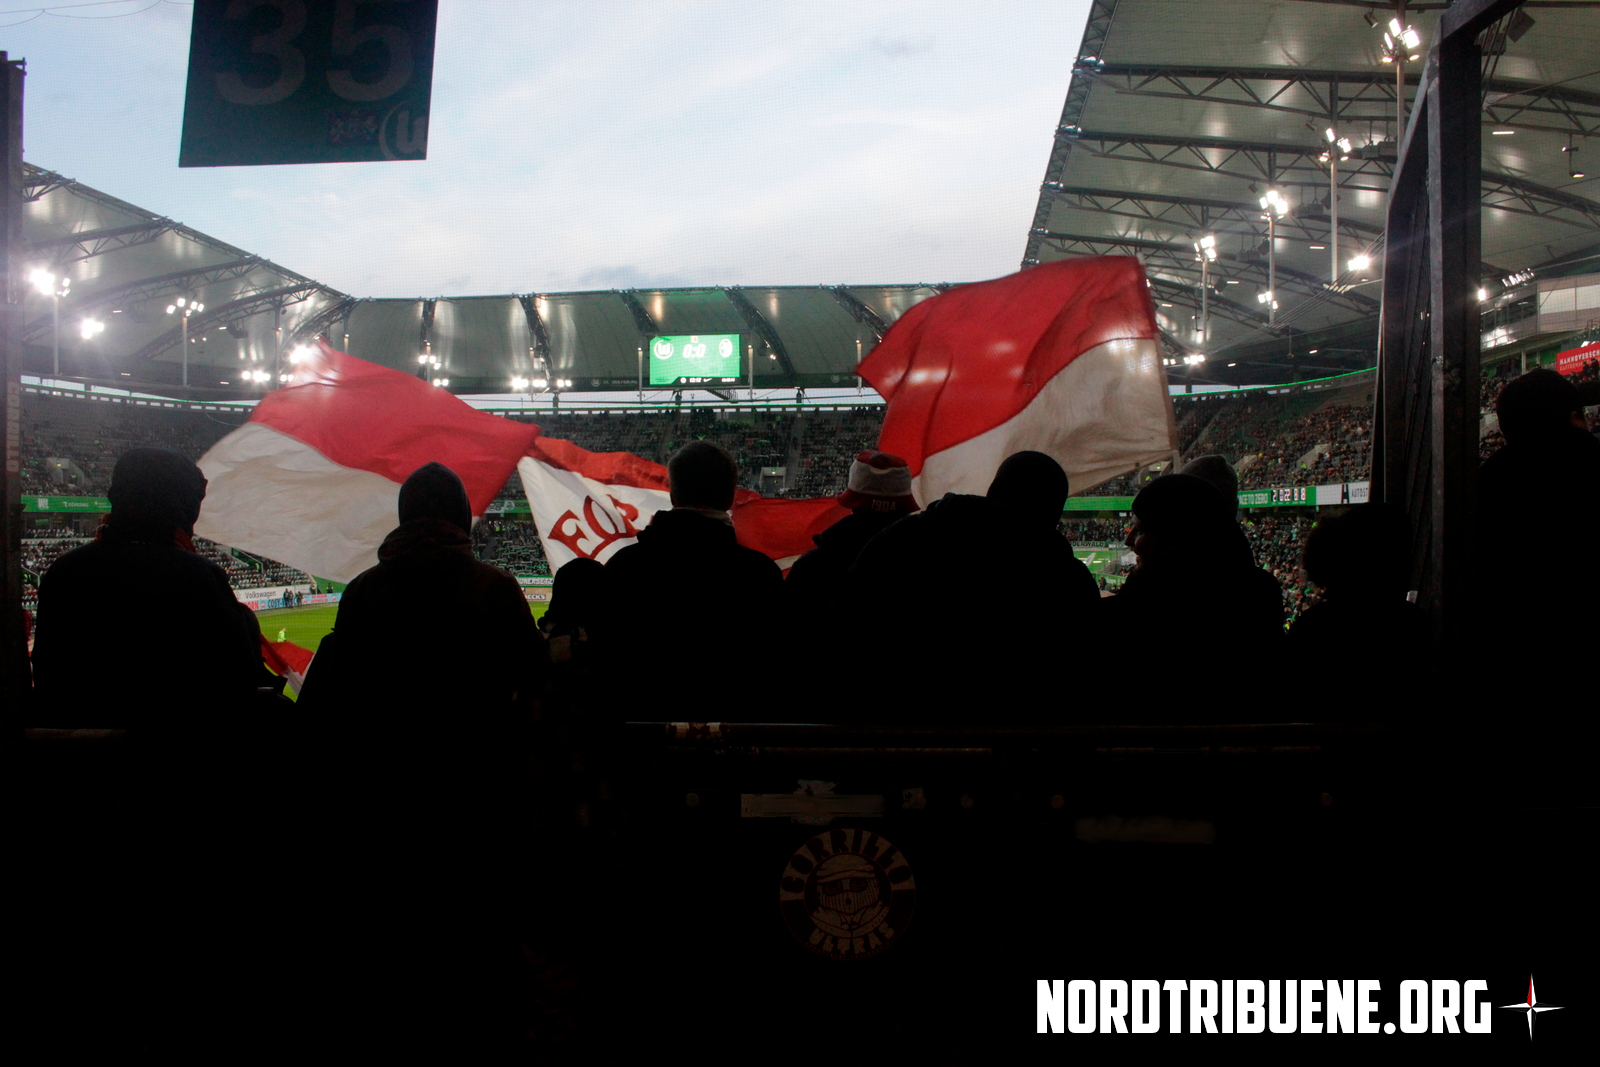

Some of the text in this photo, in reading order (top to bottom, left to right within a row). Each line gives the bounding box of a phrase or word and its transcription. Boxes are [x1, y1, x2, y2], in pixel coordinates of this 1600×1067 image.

[216, 0, 415, 105] 35
[682, 343, 707, 359] 0:0
[871, 498, 897, 512] 1904
[245, 590, 277, 600] Volkswagen
[808, 920, 896, 955] ULTRAS
